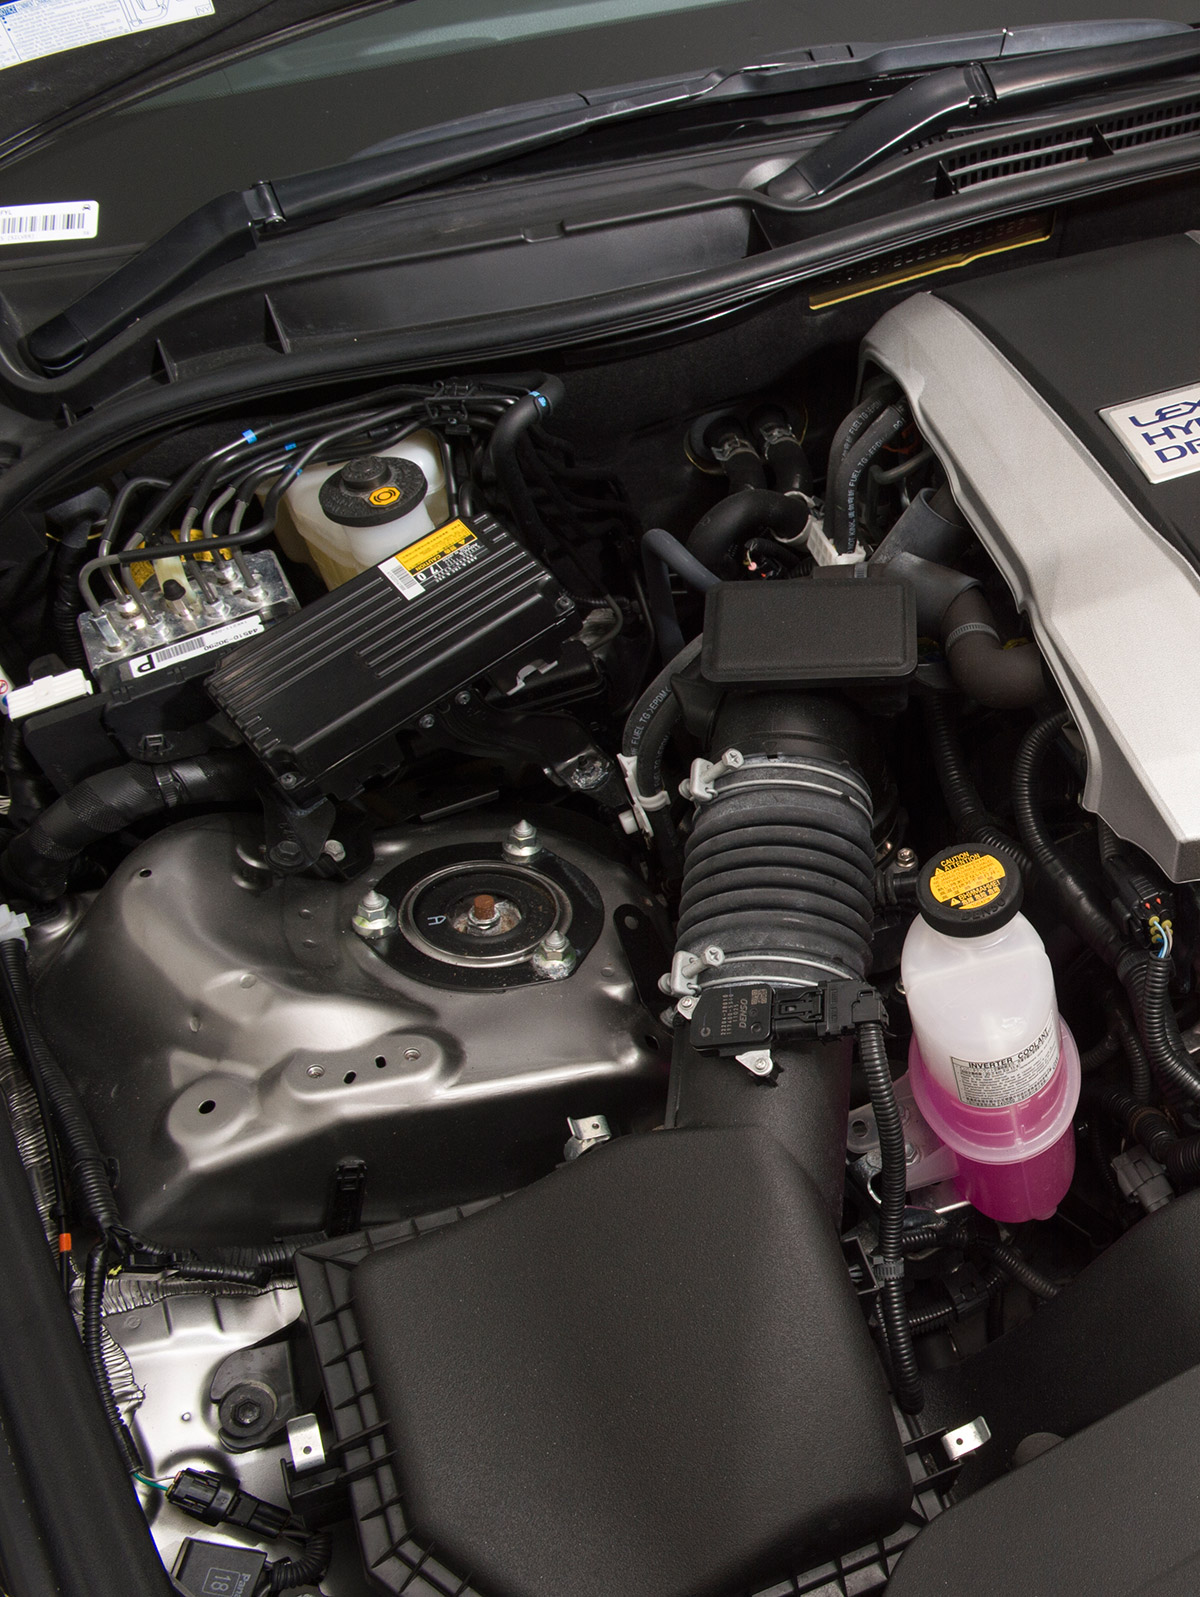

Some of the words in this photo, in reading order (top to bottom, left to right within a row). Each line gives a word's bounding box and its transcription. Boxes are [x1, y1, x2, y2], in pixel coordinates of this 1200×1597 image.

[848, 417, 863, 435] FUEL
[848, 469, 862, 487] FUEL
[415, 554, 442, 572] CAUTION
[137, 654, 156, 673] P
[631, 726, 645, 745] FUEL
[639, 713, 651, 726] TG
[940, 851, 970, 867] CAUTION
[944, 853, 980, 872] ATTENTION
[739, 998, 748, 1029] DENSO
[968, 1057, 1013, 1069] INVERTER
[1018, 1028, 1050, 1059] COOLANT
[211, 1575, 231, 1592] 18
